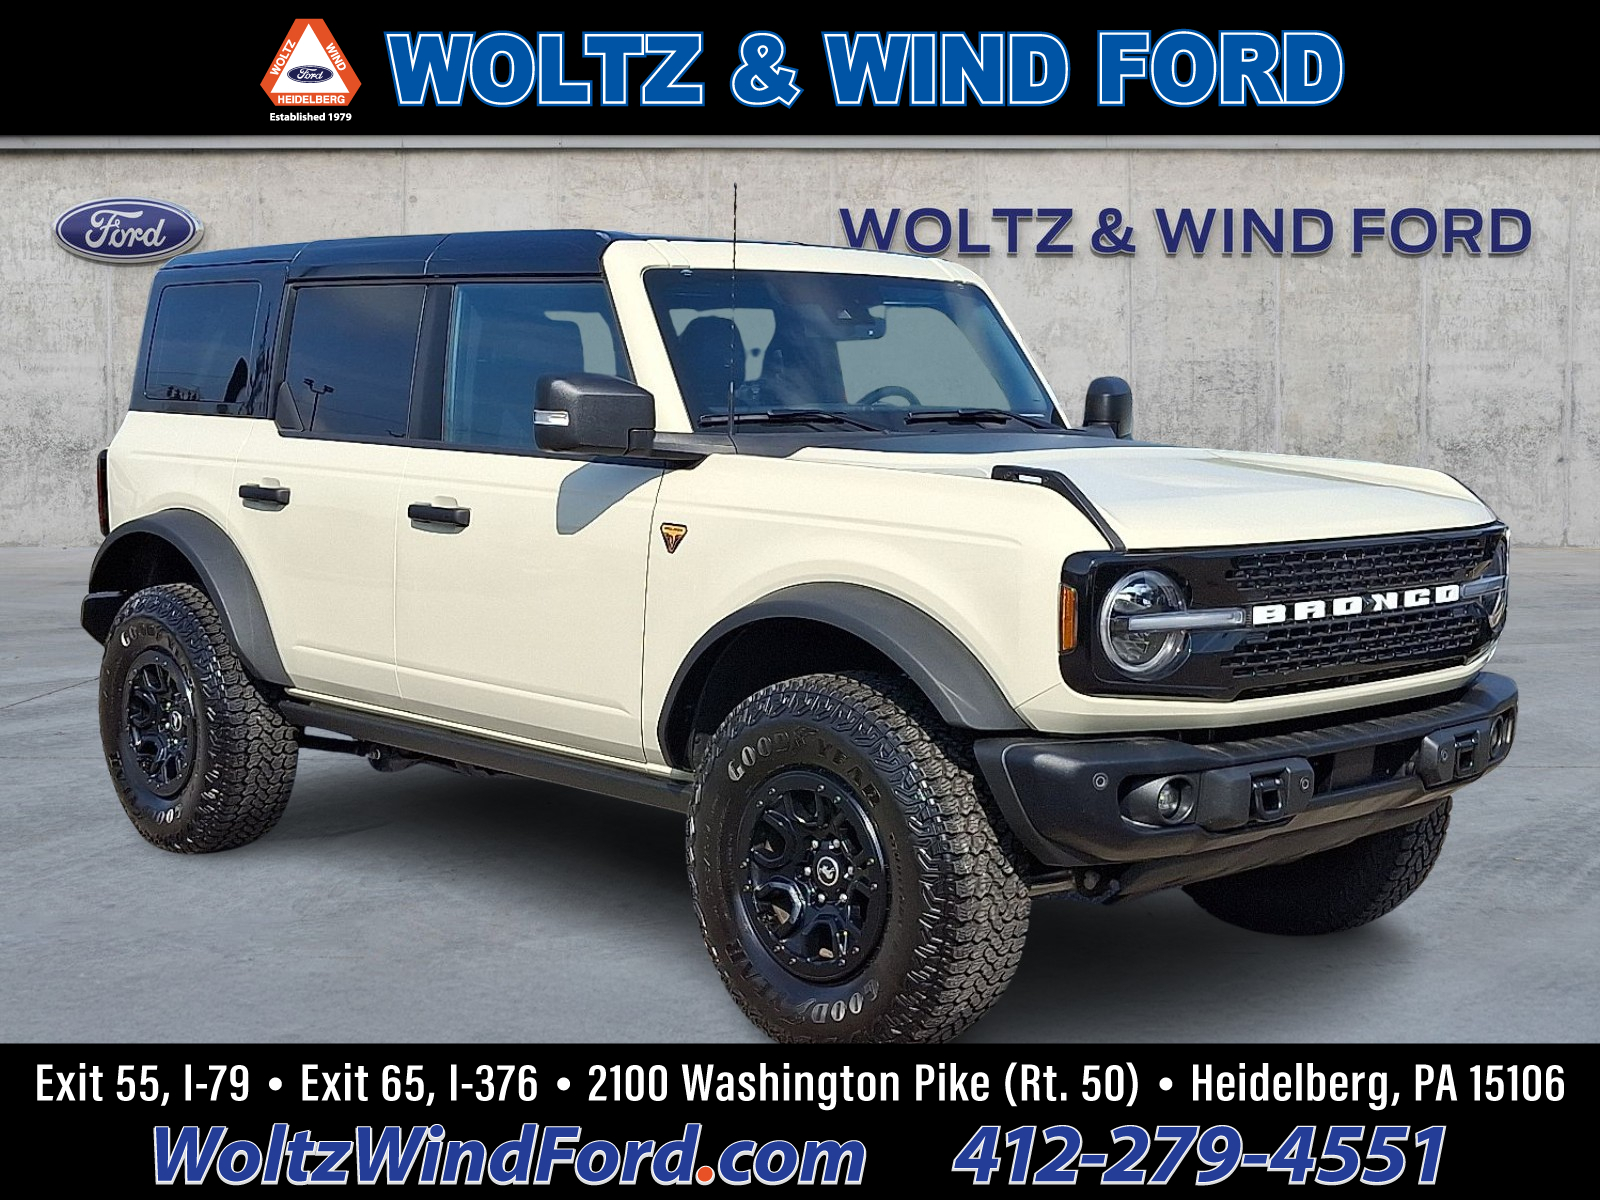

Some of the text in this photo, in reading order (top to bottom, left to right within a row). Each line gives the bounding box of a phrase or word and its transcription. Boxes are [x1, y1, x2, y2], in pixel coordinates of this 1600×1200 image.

[85, 209, 166, 248] Ford
[839, 207, 1533, 255] WOLTZ & WIND FORD
[1252, 584, 1460, 626] BRONCO
